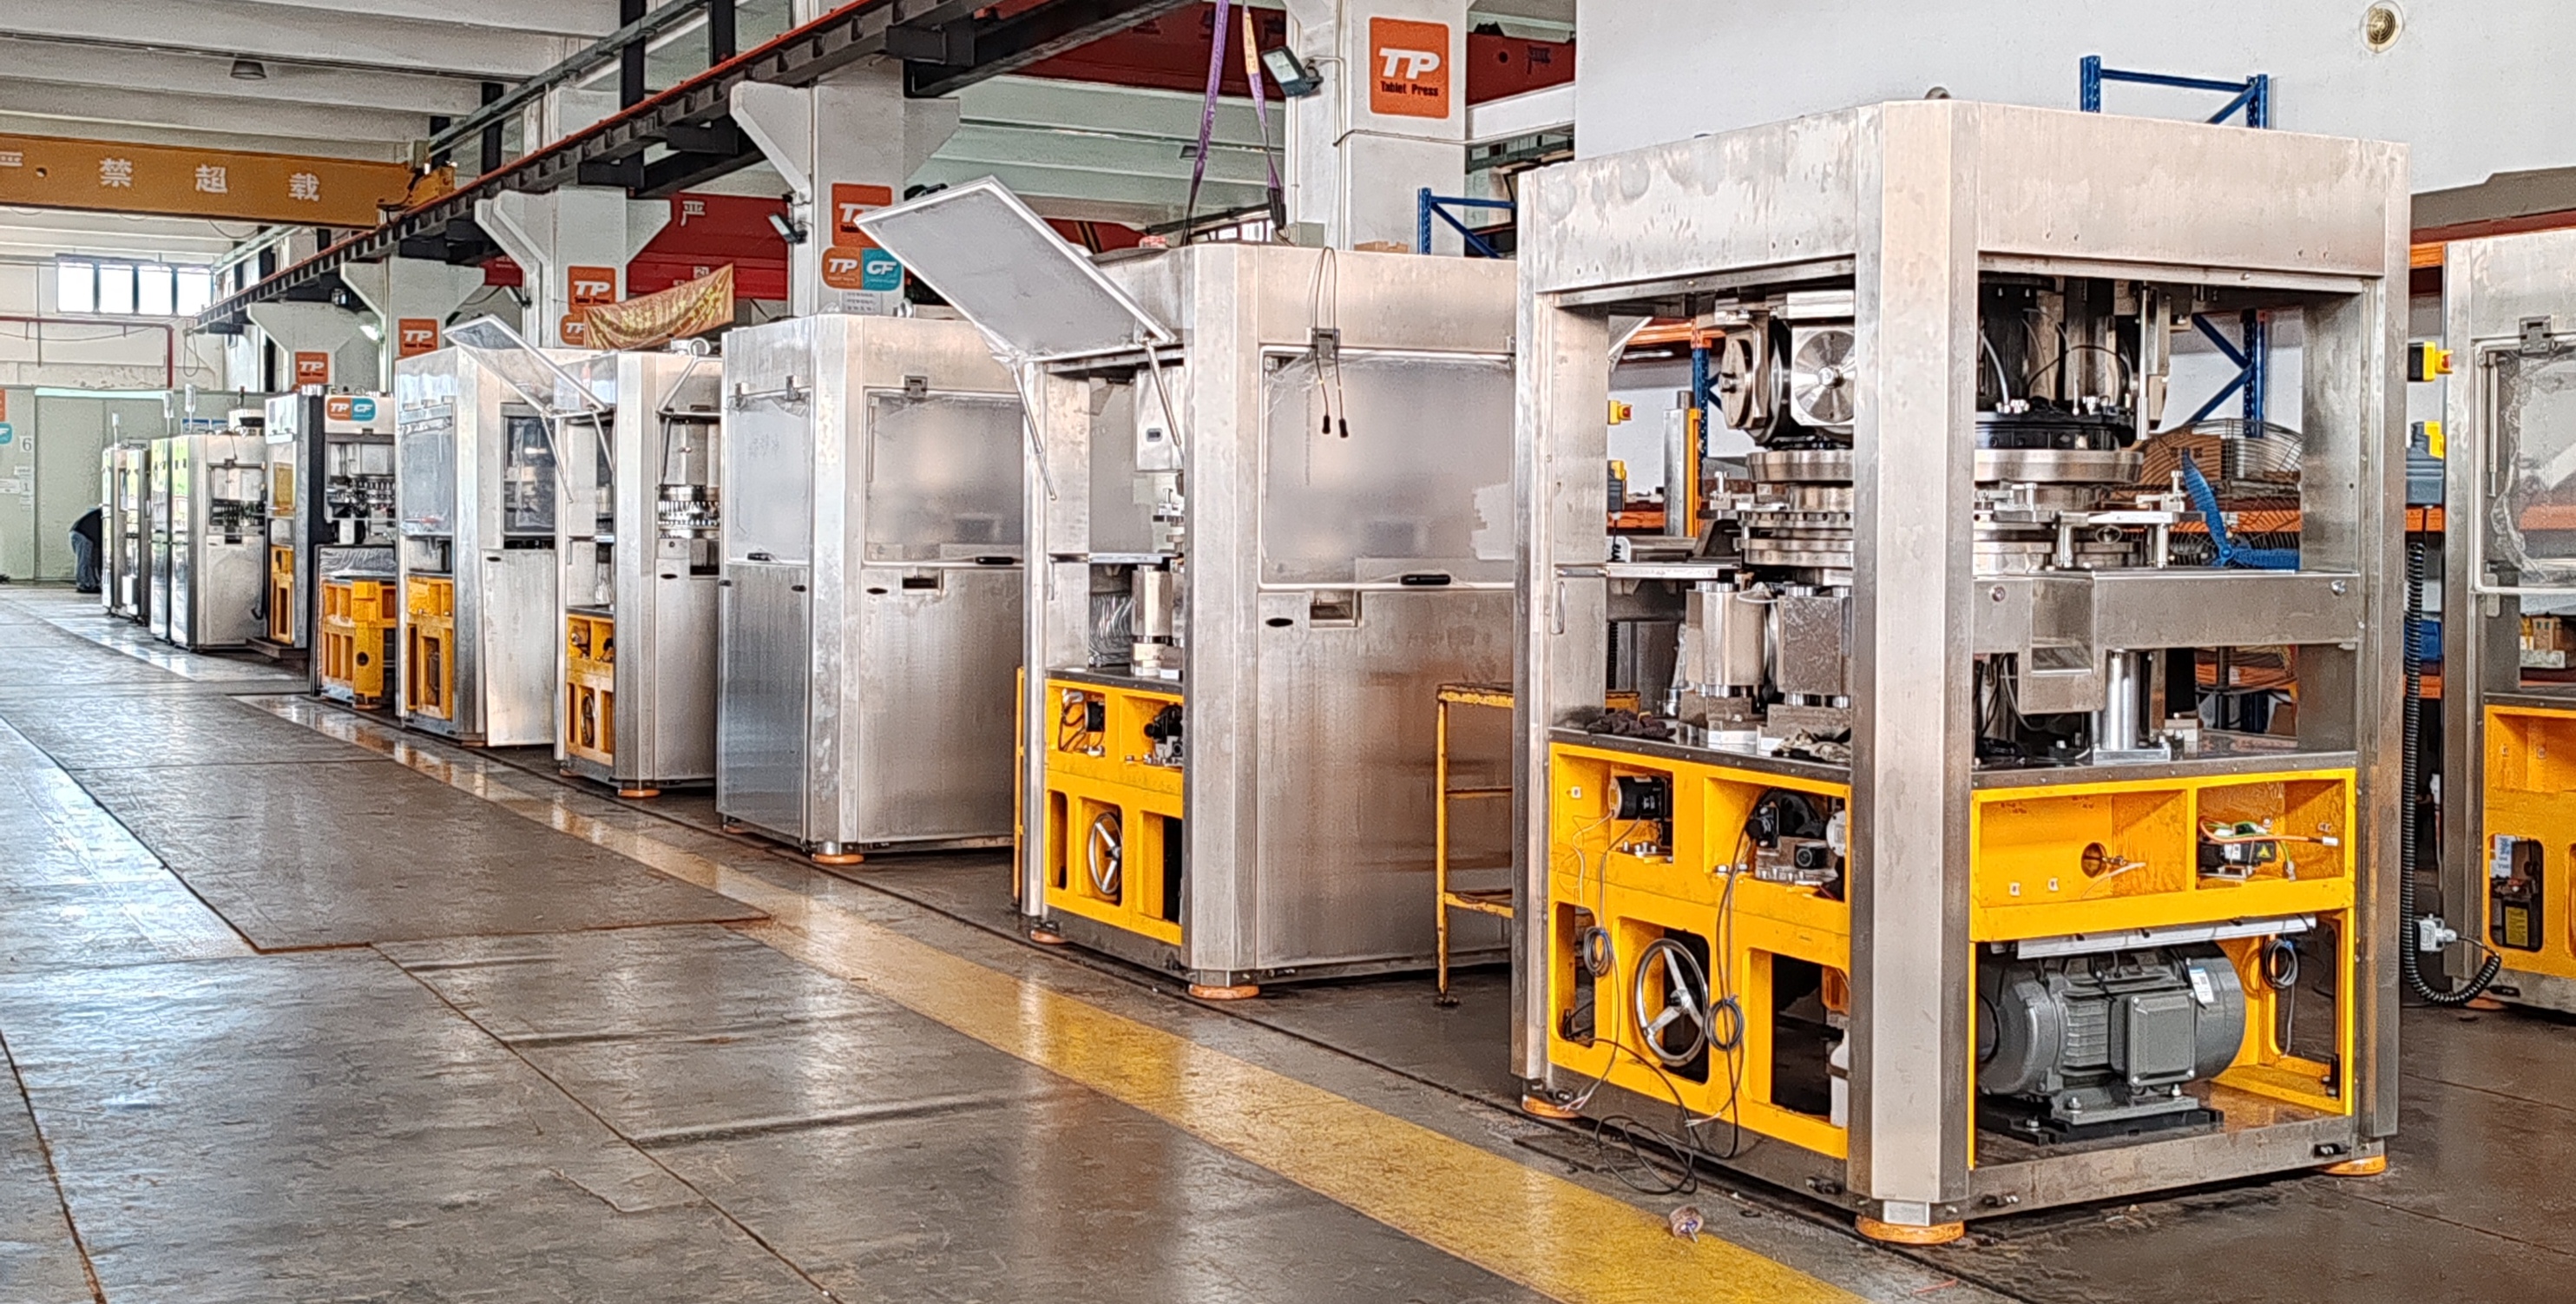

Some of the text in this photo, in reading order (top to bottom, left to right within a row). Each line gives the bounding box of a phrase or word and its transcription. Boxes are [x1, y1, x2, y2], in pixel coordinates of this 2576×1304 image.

[1379, 48, 1440, 79] TP
[1380, 81, 1439, 96] Tablet Press
[828, 258, 897, 275] TP CF
[574, 280, 611, 295] TP
[403, 330, 433, 341] TP
[299, 361, 325, 372] TP
[330, 403, 373, 413] TP CF
[22, 438, 32, 451] 6
